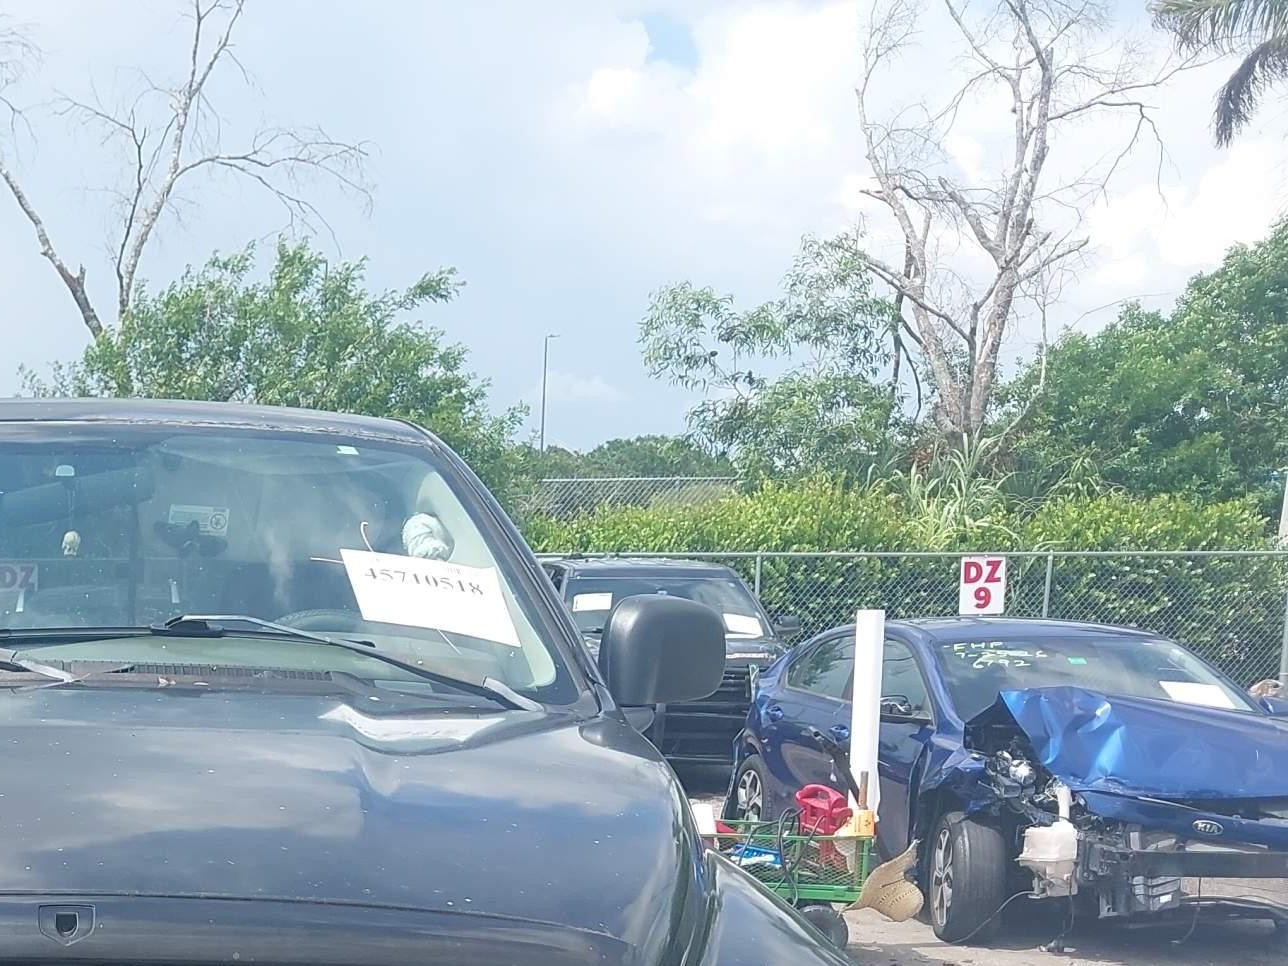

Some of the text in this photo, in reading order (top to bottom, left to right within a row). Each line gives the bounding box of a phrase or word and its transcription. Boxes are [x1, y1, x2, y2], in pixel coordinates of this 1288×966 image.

[364, 566, 484, 596] 45710518
[964, 560, 1003, 584] DZ
[974, 586, 991, 609] 9
[1197, 822, 1218, 833] KIA
